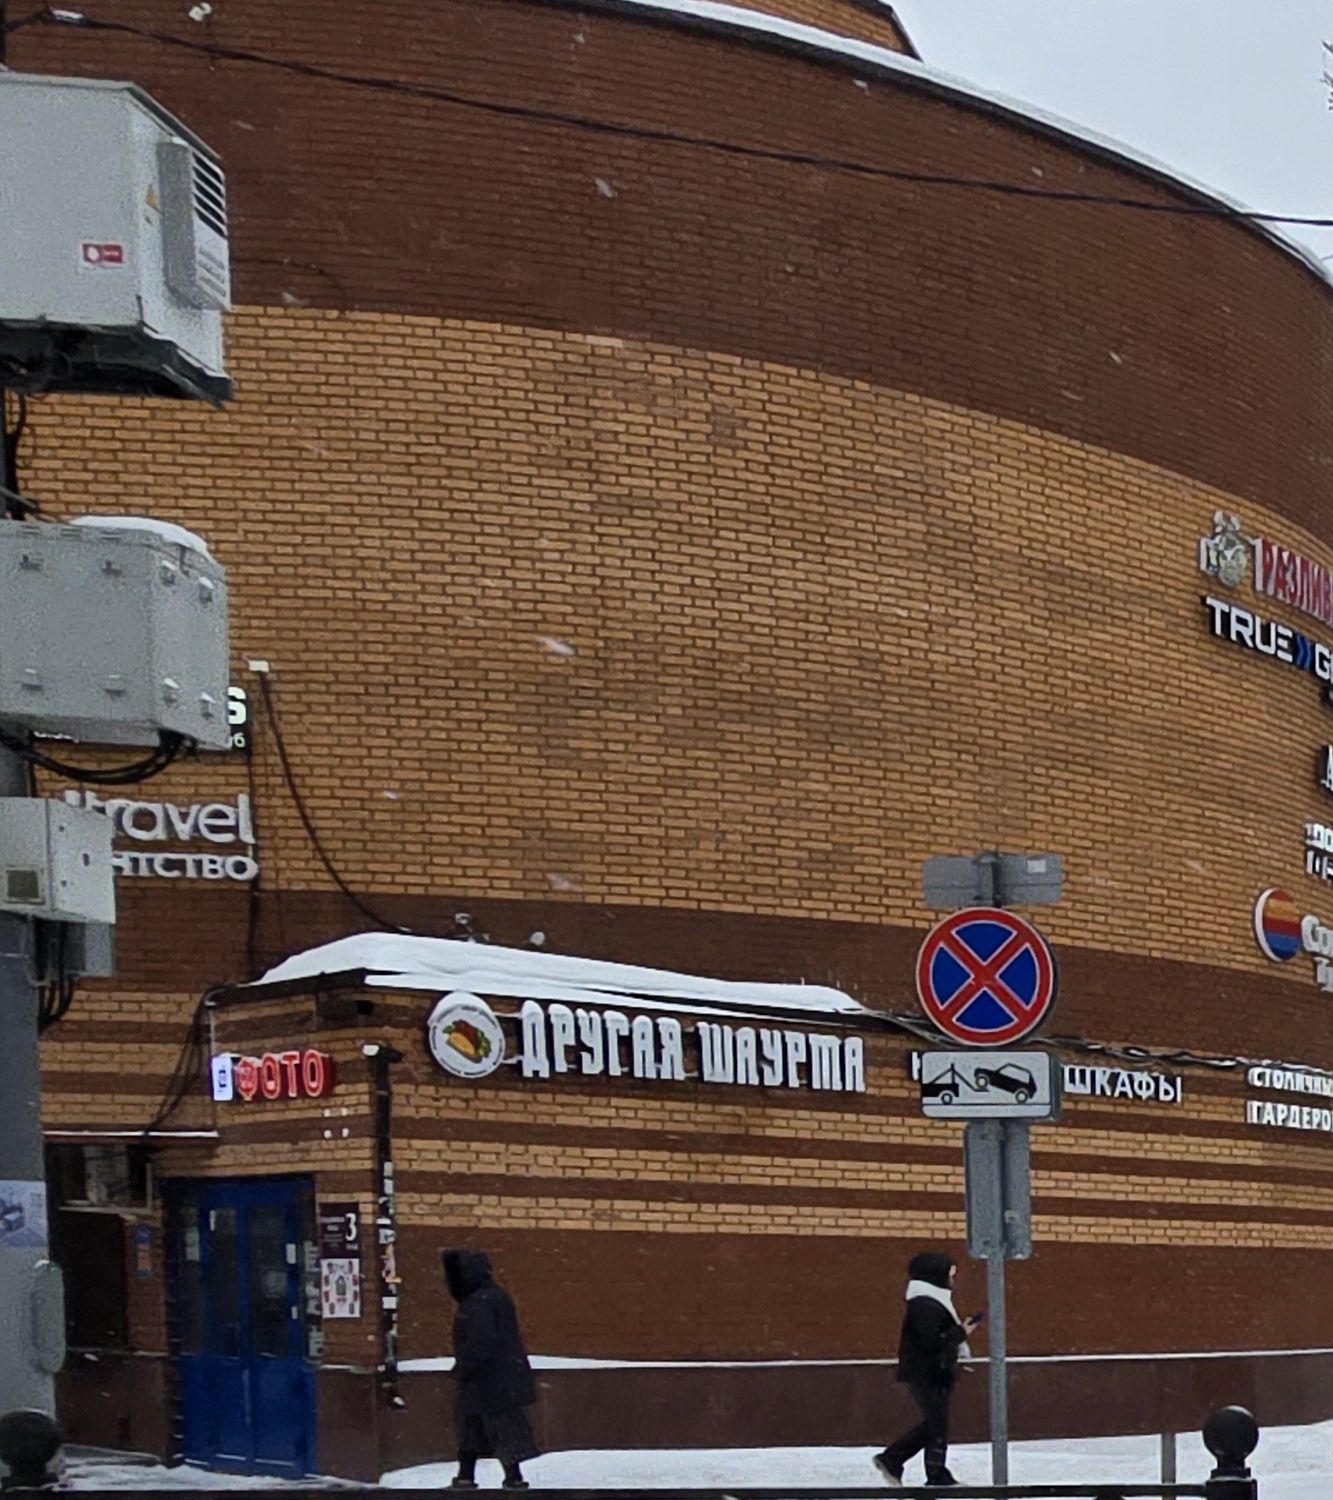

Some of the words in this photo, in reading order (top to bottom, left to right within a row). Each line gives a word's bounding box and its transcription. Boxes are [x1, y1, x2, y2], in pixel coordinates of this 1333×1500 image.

[1205, 596, 1294, 662] TRUE
[520, 999, 687, 1081] ДРУГАЯ
[696, 1021, 867, 1093] ШАУРМА
[1062, 1065, 1182, 1104] ШКАФЫ
